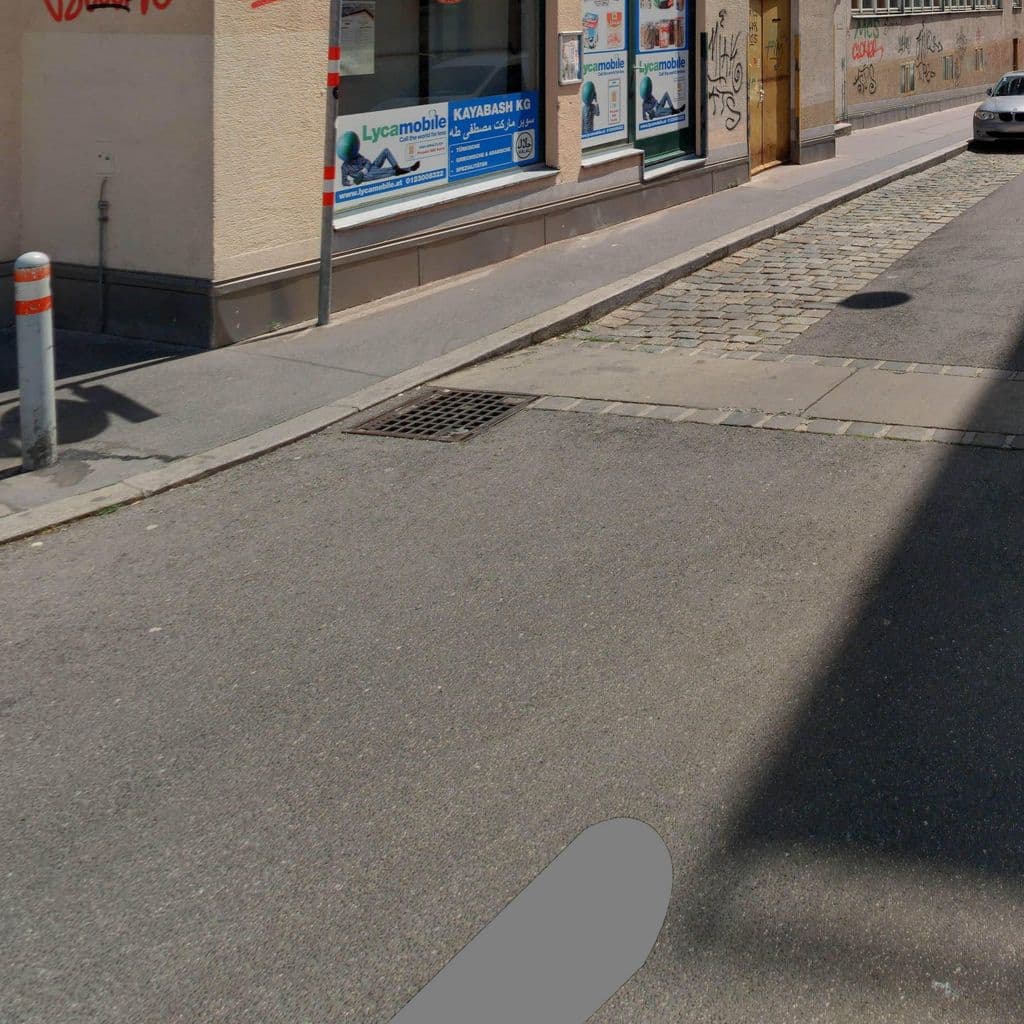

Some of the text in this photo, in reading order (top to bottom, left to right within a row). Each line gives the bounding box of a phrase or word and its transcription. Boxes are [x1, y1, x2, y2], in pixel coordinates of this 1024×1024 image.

[583, 58, 624, 75] ycamobile
[453, 98, 531, 121] KAYABASH KG
[362, 115, 446, 143] Lycamobile
